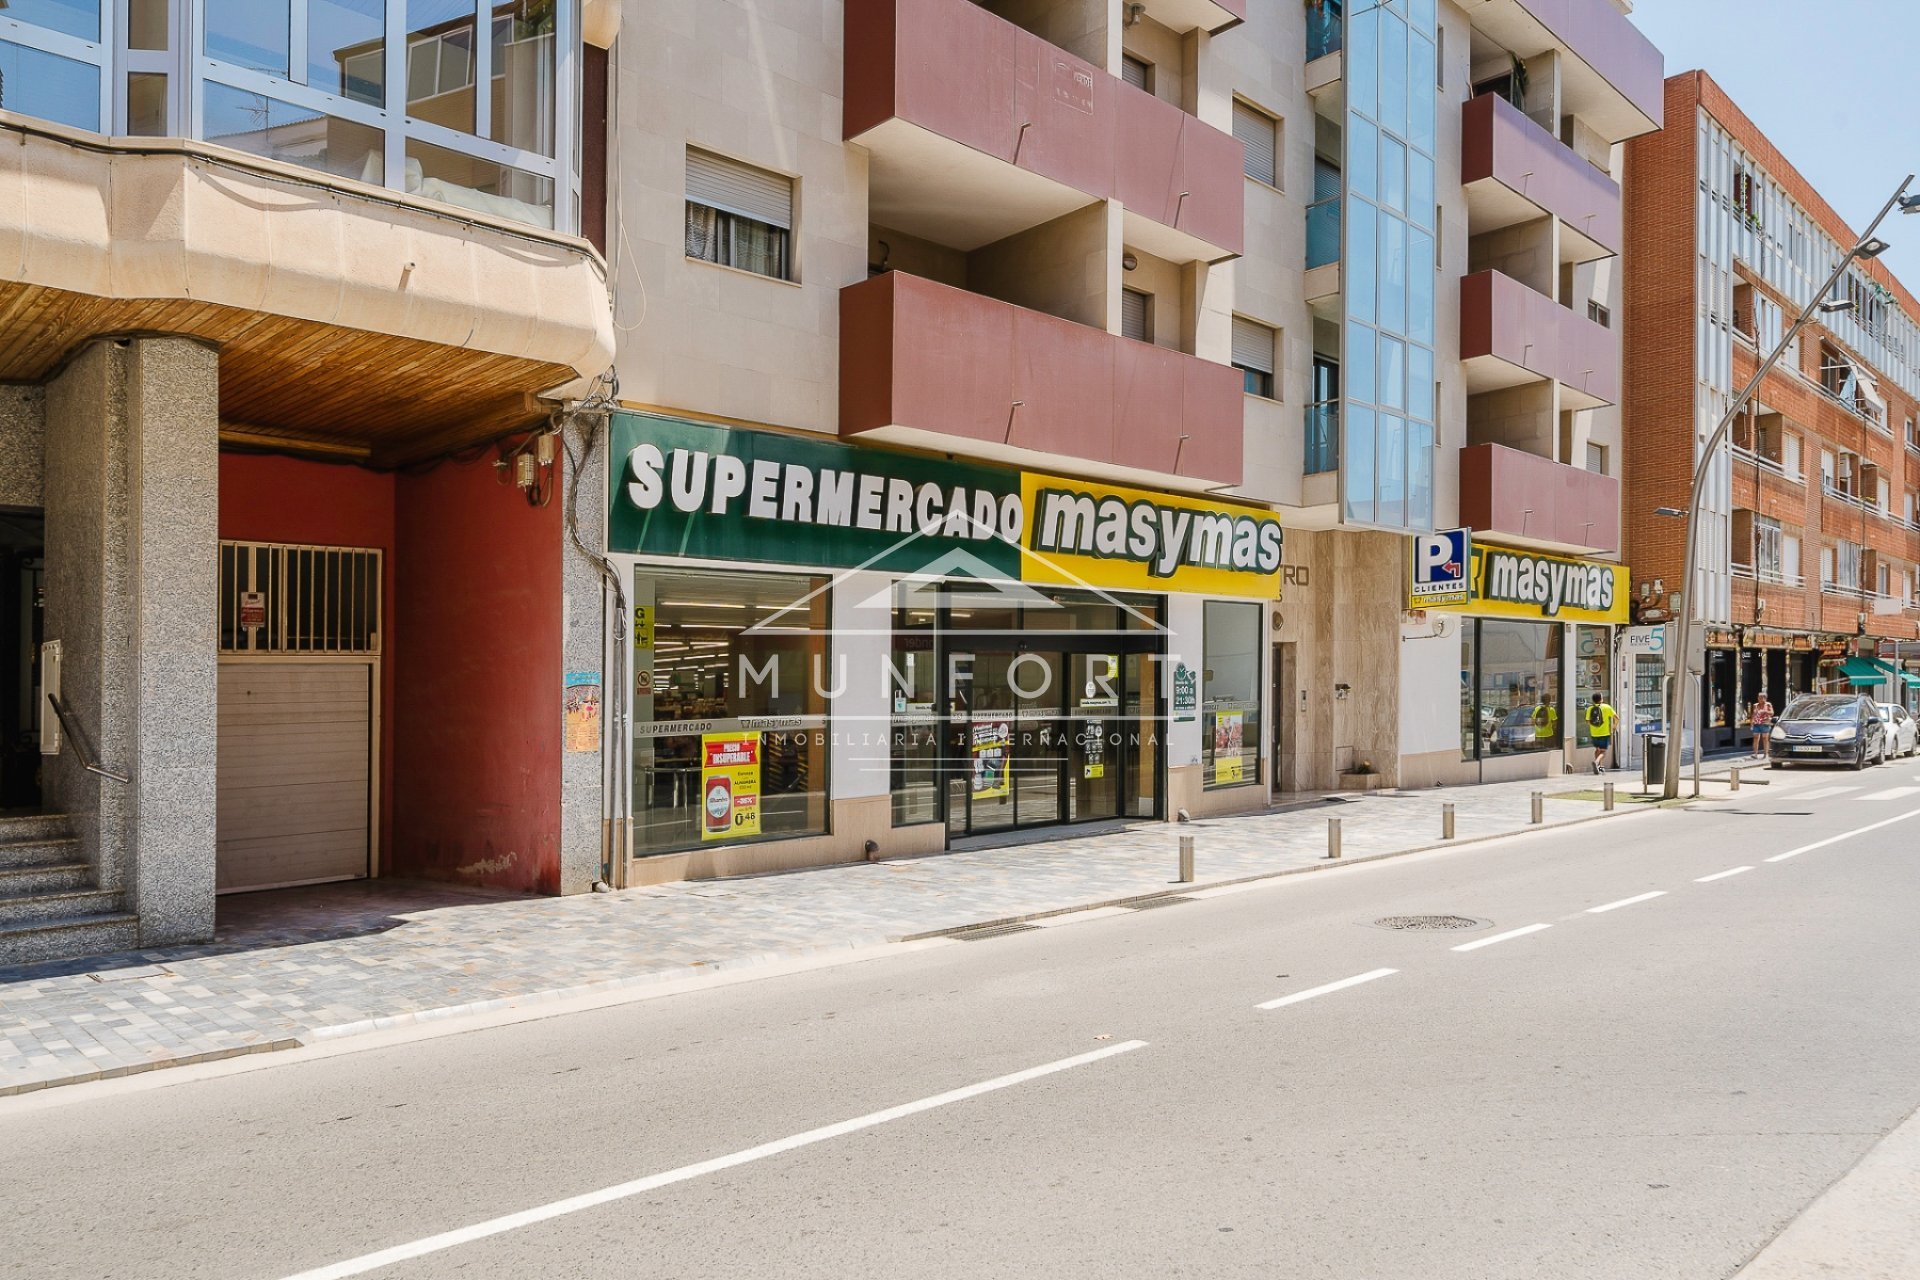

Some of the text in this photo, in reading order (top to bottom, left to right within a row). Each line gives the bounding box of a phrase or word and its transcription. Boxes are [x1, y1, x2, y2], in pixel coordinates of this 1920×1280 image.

[627, 443, 1282, 577] SUPERMERCADO masymas
[1418, 534, 1453, 582] P
[1280, 564, 1309, 586] RO
[1490, 553, 1614, 616] masymas
[1414, 582, 1464, 593] CLIENTES
[1630, 627, 1665, 651] FIVE 5
[1176, 686, 1188, 695] 9:00
[639, 717, 802, 735] SUPERMERCADO masymas
